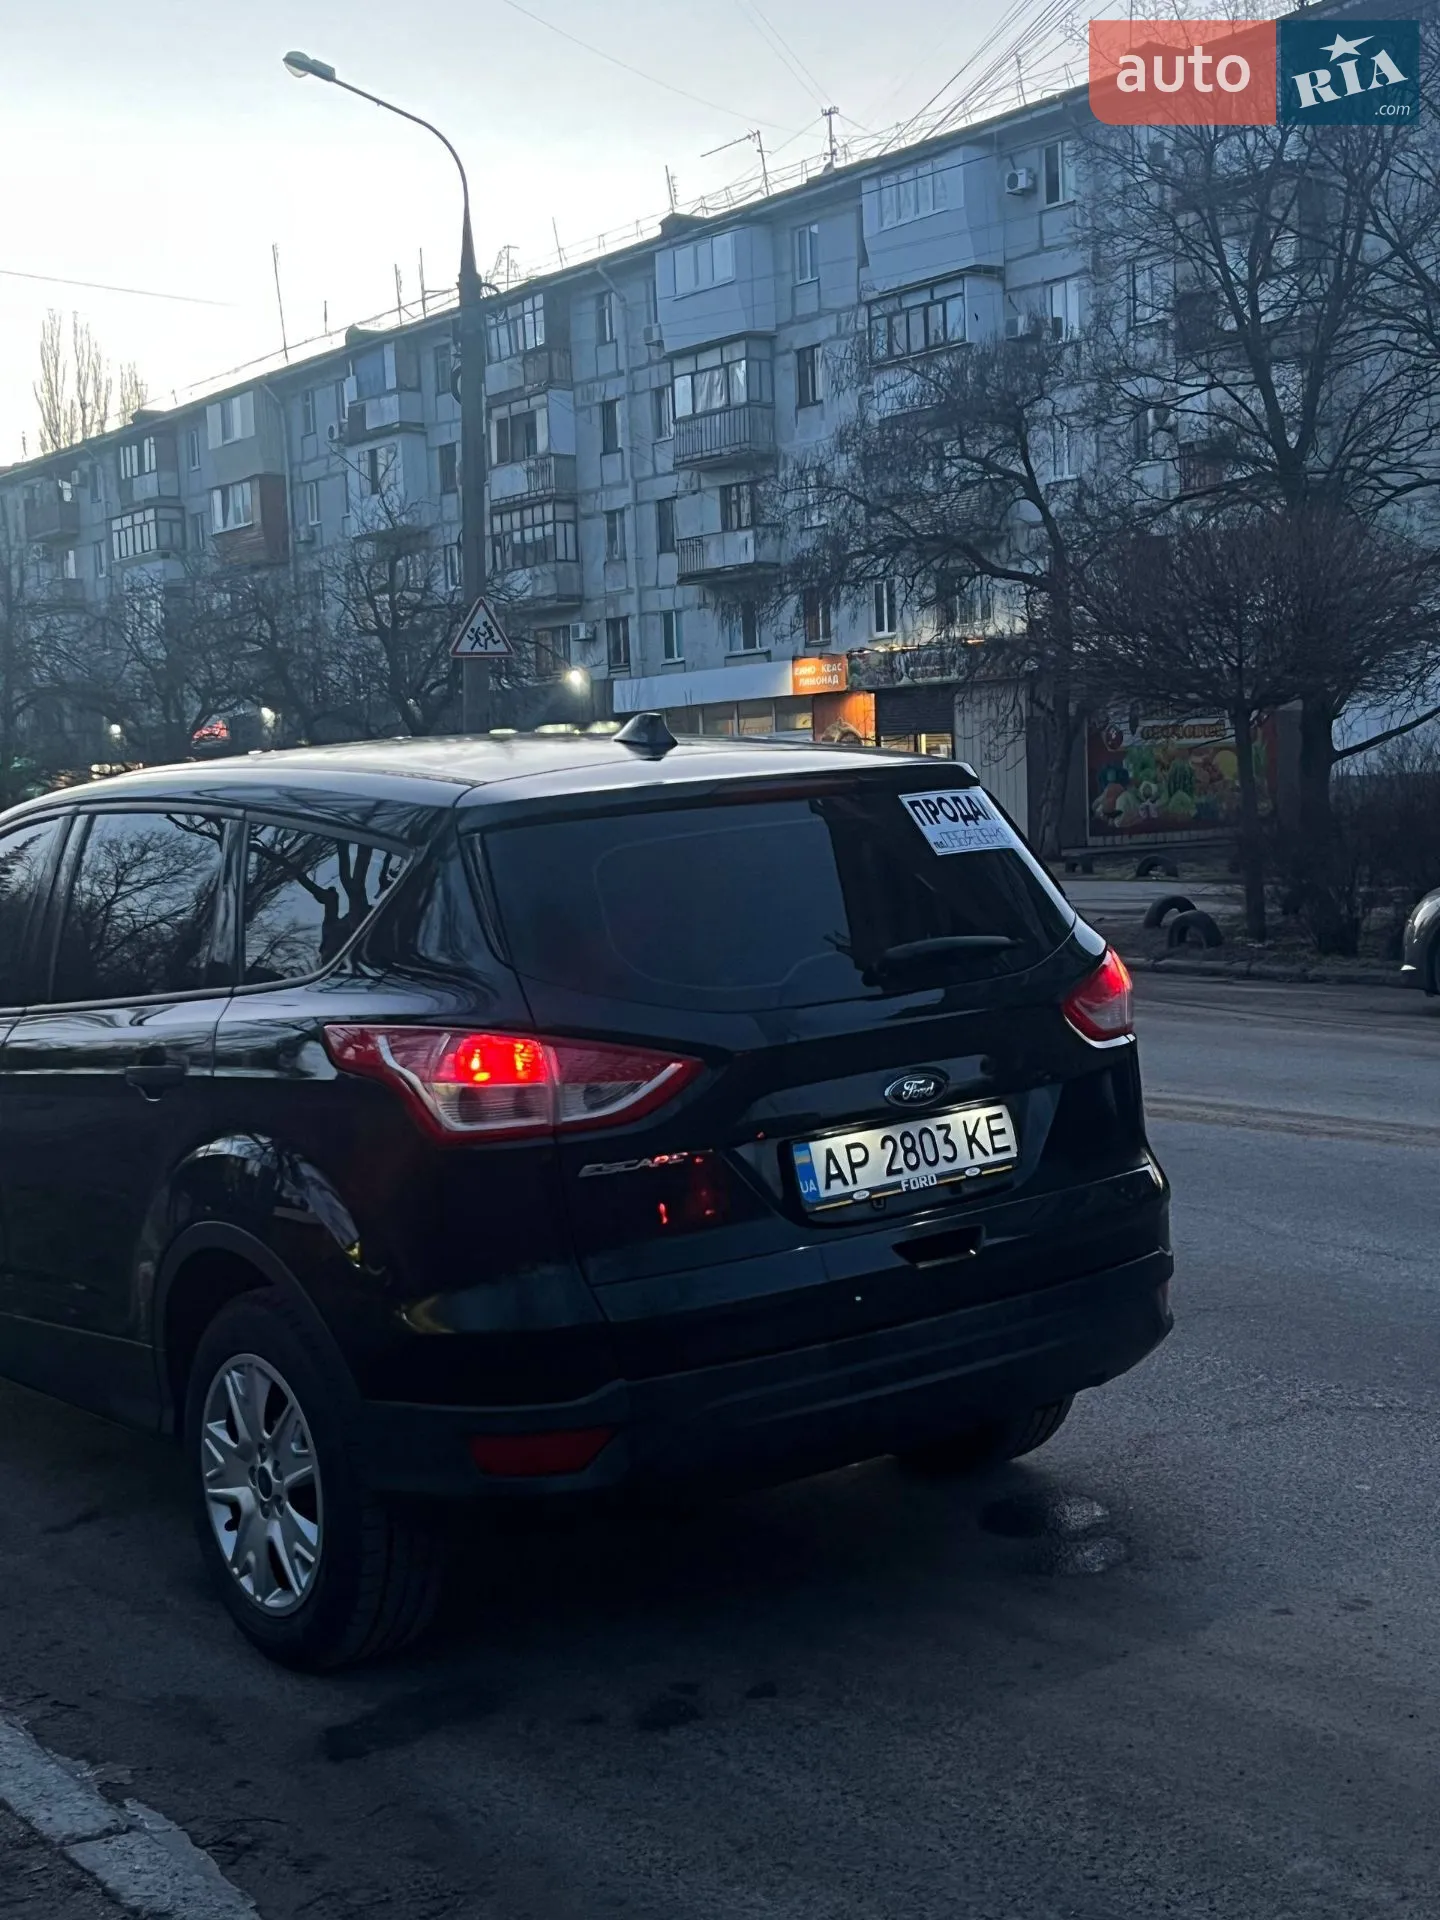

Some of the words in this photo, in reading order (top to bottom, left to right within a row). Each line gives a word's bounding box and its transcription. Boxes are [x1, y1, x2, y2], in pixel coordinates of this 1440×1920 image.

[822, 662, 842, 673] КВАС
[799, 674, 839, 687] ЛИМОНАД
[902, 1079, 935, 1101] Ford
[824, 1141, 870, 1190] AP
[880, 1123, 958, 1177] 2803
[963, 1112, 1011, 1160] KE
[800, 1178, 817, 1194] UA
[901, 1174, 938, 1192] FORD
